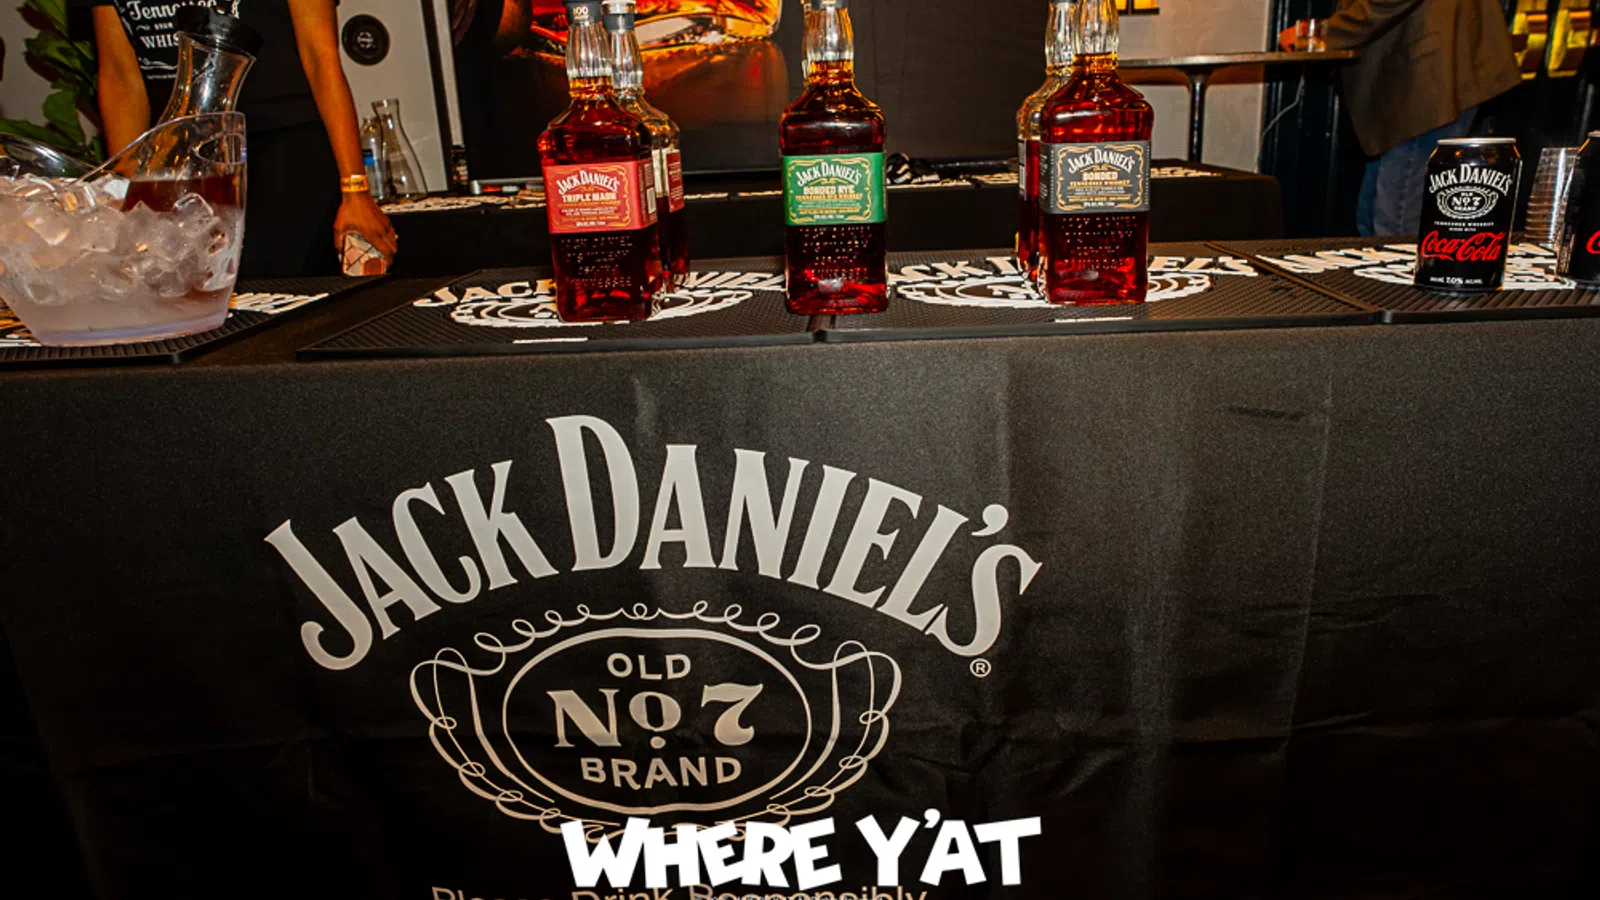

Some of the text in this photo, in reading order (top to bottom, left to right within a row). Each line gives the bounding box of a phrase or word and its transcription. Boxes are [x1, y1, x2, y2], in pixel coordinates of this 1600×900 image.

[795, 166, 822, 187] JACK
[820, 161, 862, 185] DANIEL'S
[1067, 148, 1136, 174] JACK DANIEL'S
[556, 173, 581, 195] JACK
[579, 169, 621, 194] DANIEL'S
[1082, 171, 1118, 181] BONDED
[1429, 164, 1513, 196] JACK DANIEL'S
[561, 191, 618, 203] TRIPLE MASH
[803, 184, 856, 195] BONDED RYE
[1472, 196, 1483, 207] 7
[265, 414, 1043, 671] JACK DANIEL'S
[606, 653, 692, 681] OLD
[700, 682, 765, 747] 7
[580, 756, 743, 789] BRAND
